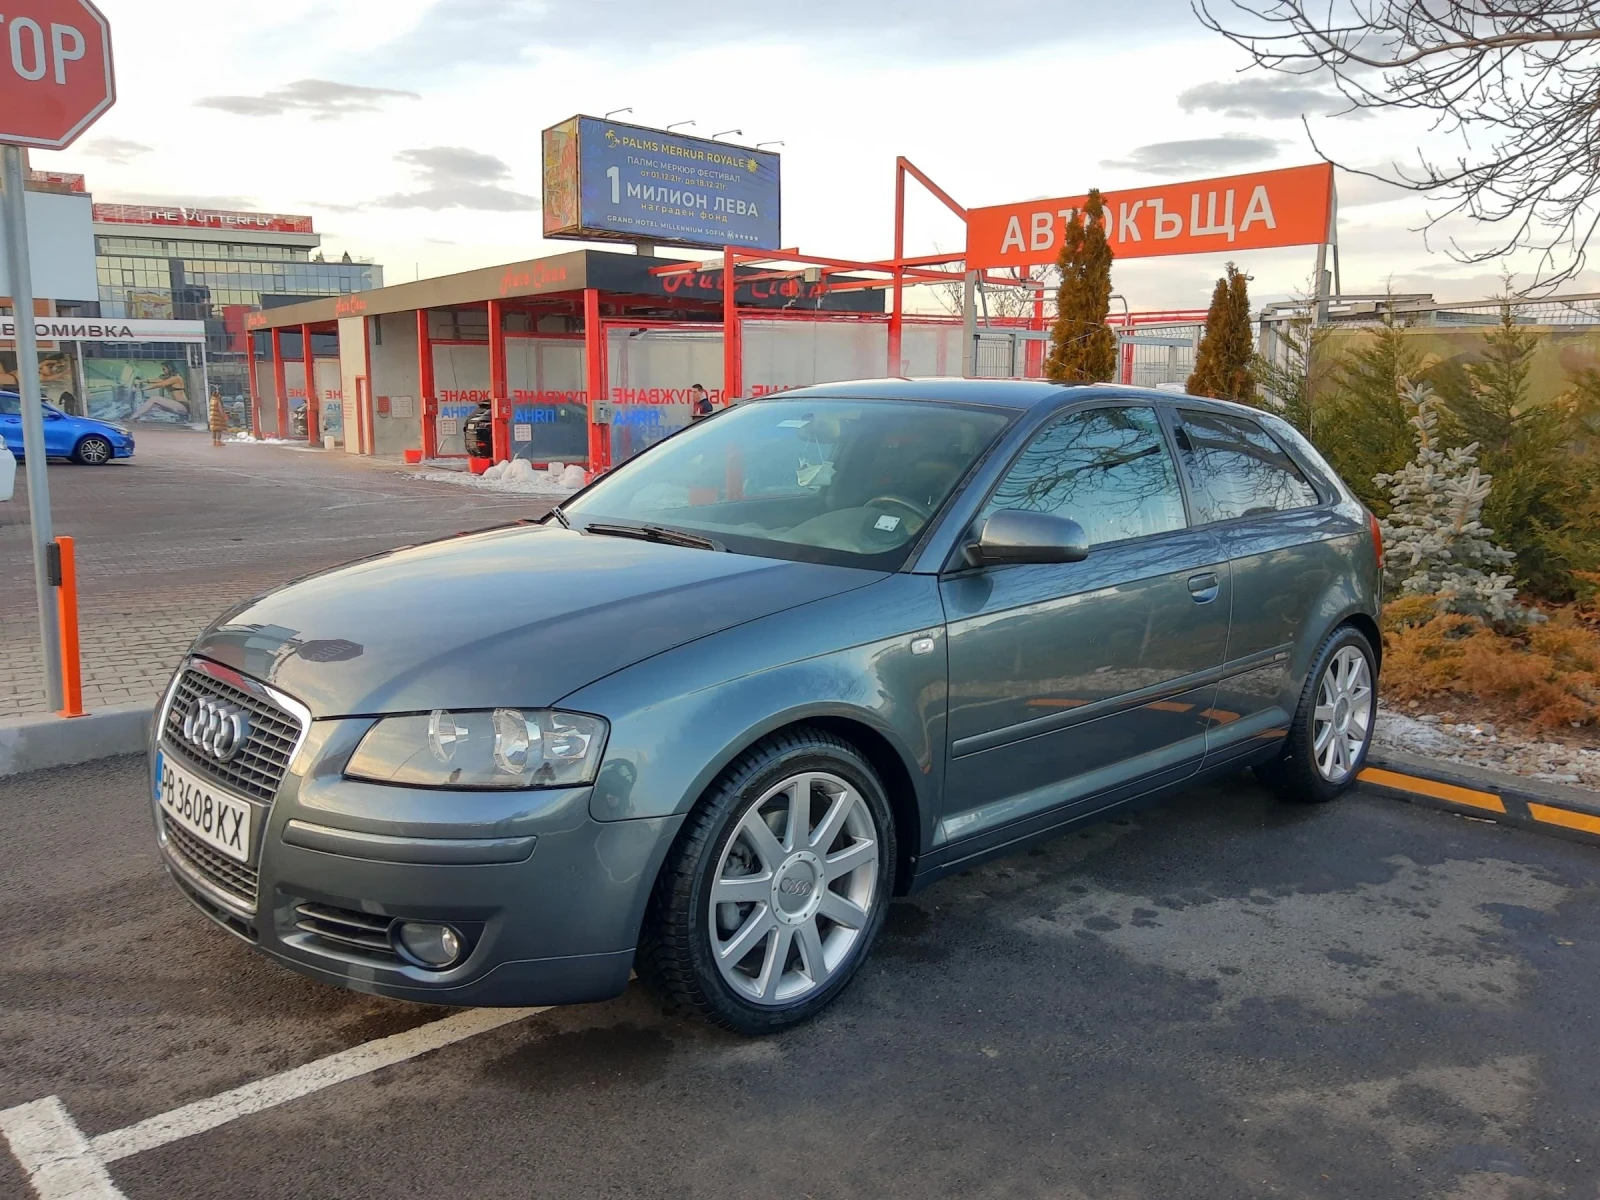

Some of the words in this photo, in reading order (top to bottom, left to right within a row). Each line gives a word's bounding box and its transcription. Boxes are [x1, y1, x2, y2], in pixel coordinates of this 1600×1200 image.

[0, 13, 86, 85] OP
[622, 137, 659, 152] PALMS
[661, 144, 704, 161] MERKUR
[707, 153, 745, 168] ROYALE
[627, 156, 658, 168] ПАЛМС
[660, 161, 695, 175] МЕРКЮР
[697, 169, 741, 183] ФЕСТИВАЛ
[606, 165, 620, 204] 1
[627, 182, 707, 210] МИЛИОН
[713, 195, 759, 218] ЛЕВА
[685, 178, 695, 186] до
[146, 211, 178, 221] THE
[641, 203, 694, 217] награден
[699, 210, 728, 223] фонд
[606, 215, 633, 224] GRAND
[635, 219, 659, 228] HOTEL
[660, 223, 703, 234] MILLENNIUM
[705, 228, 725, 237] SOFIA
